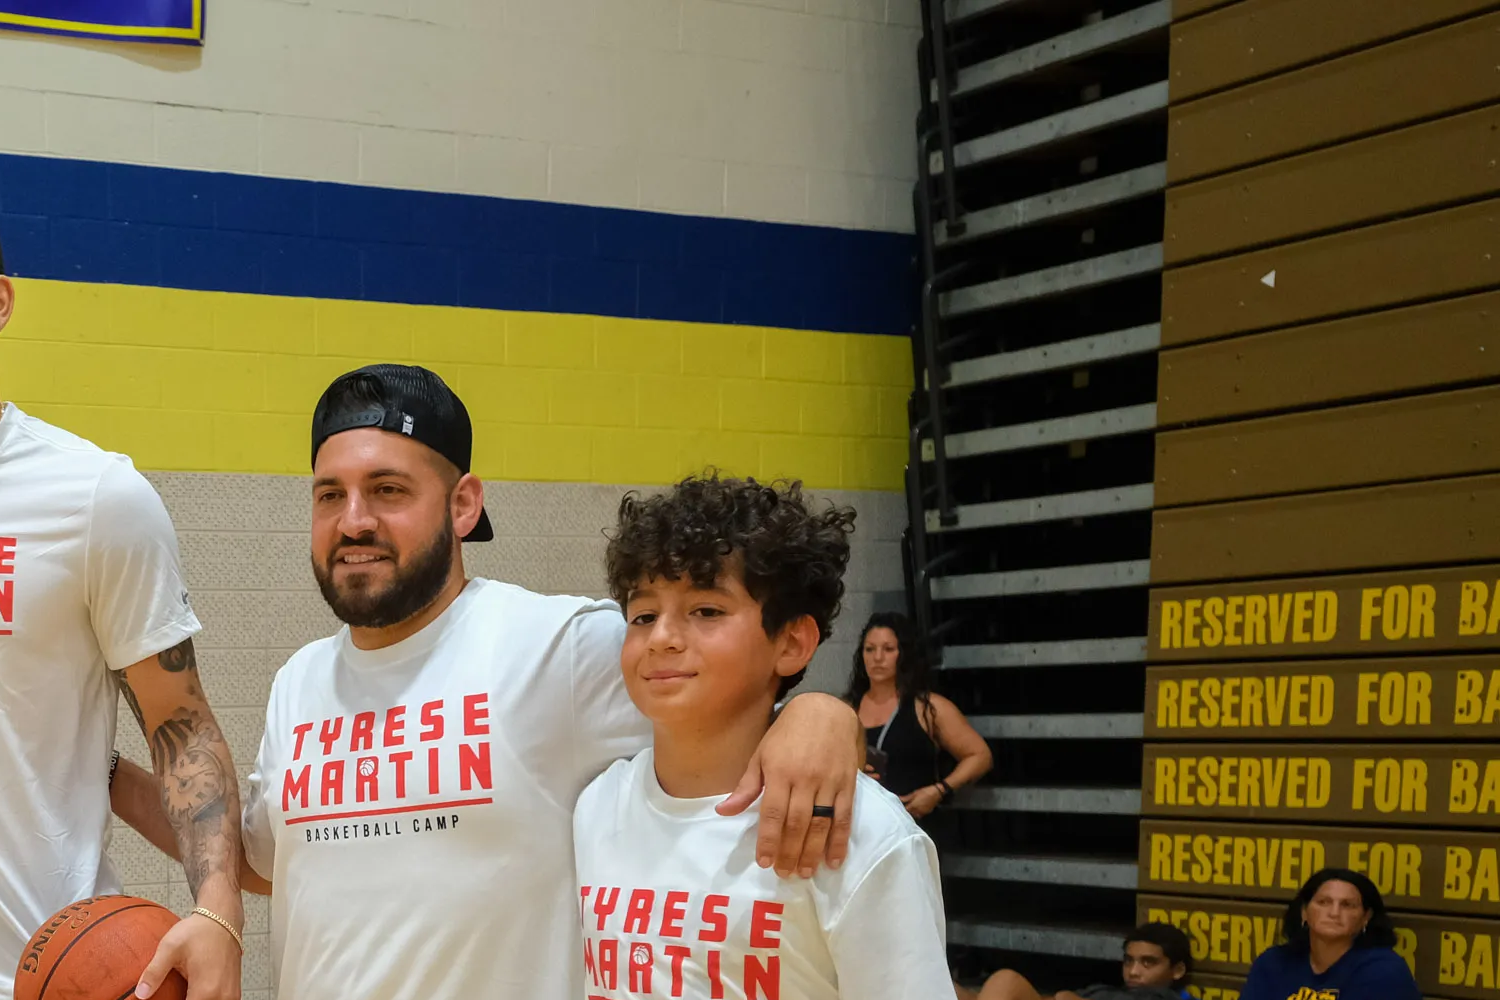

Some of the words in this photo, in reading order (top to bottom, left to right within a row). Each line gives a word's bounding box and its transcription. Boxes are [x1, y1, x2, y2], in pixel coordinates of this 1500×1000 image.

[1160, 590, 1338, 649] RESERVED
[1360, 584, 1437, 641] FOR
[292, 692, 490, 761] TYRESE
[1156, 674, 1335, 729] RESERVED
[1356, 671, 1433, 726] FOR
[281, 741, 493, 812] MARTIN
[1154, 756, 1332, 808] RESERVED
[1351, 758, 1428, 813] FOR
[306, 821, 402, 843] BASKETBALL
[412, 814, 460, 833] CAMP
[1150, 833, 1325, 890] RESERVED
[580, 885, 785, 949] TYRESE
[1439, 931, 1500, 989] BA
